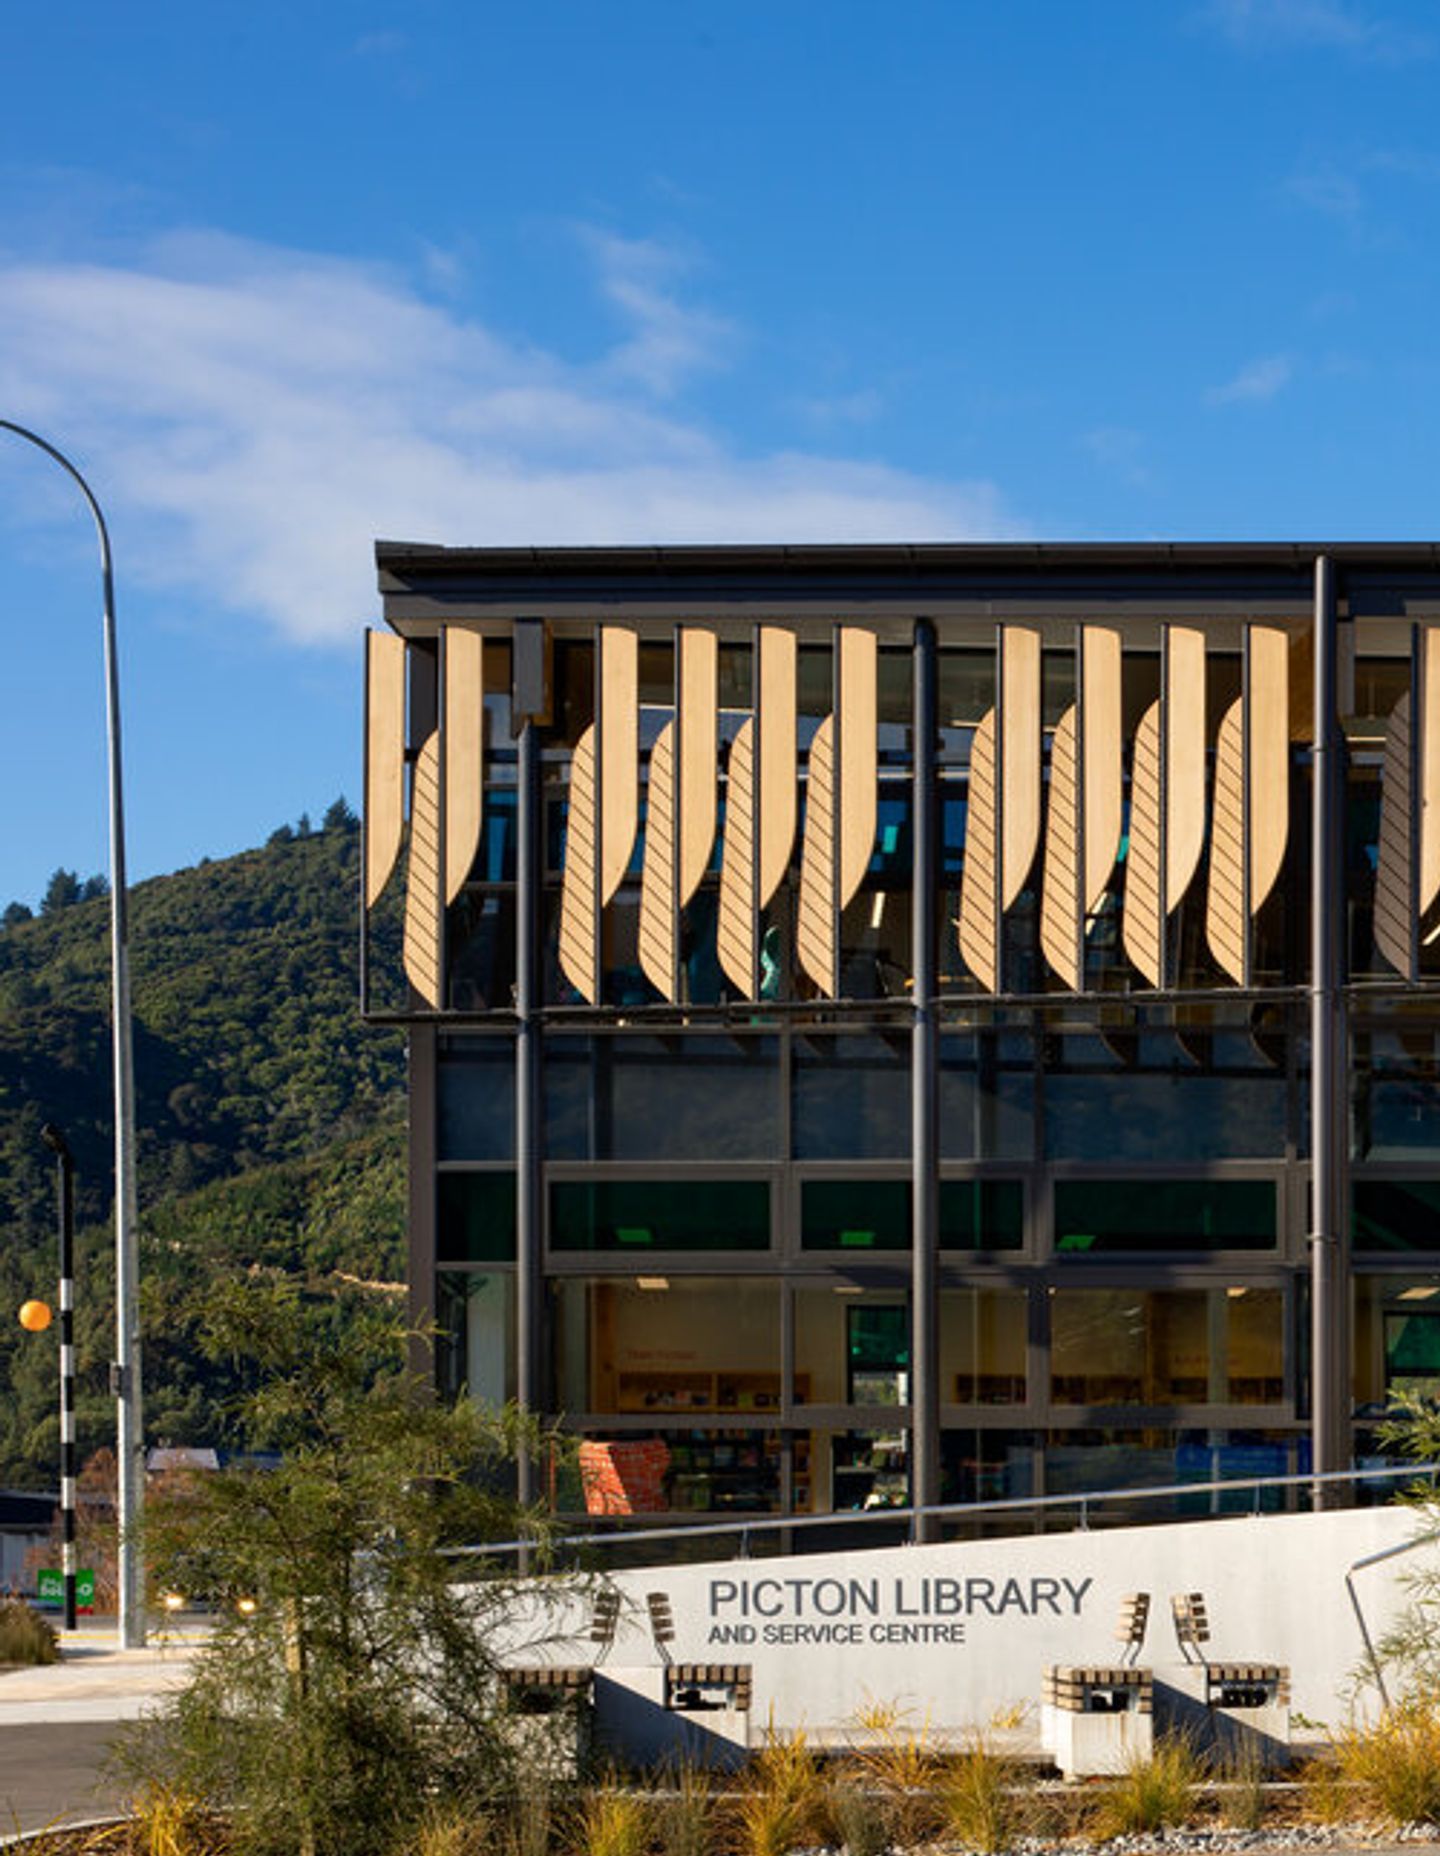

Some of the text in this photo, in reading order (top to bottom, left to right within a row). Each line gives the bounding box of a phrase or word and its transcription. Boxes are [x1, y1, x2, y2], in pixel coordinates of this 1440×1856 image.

[709, 1577, 1093, 1617] PICTON LIBRARY
[707, 1622, 966, 1645] AND SERVICE CENTRE
